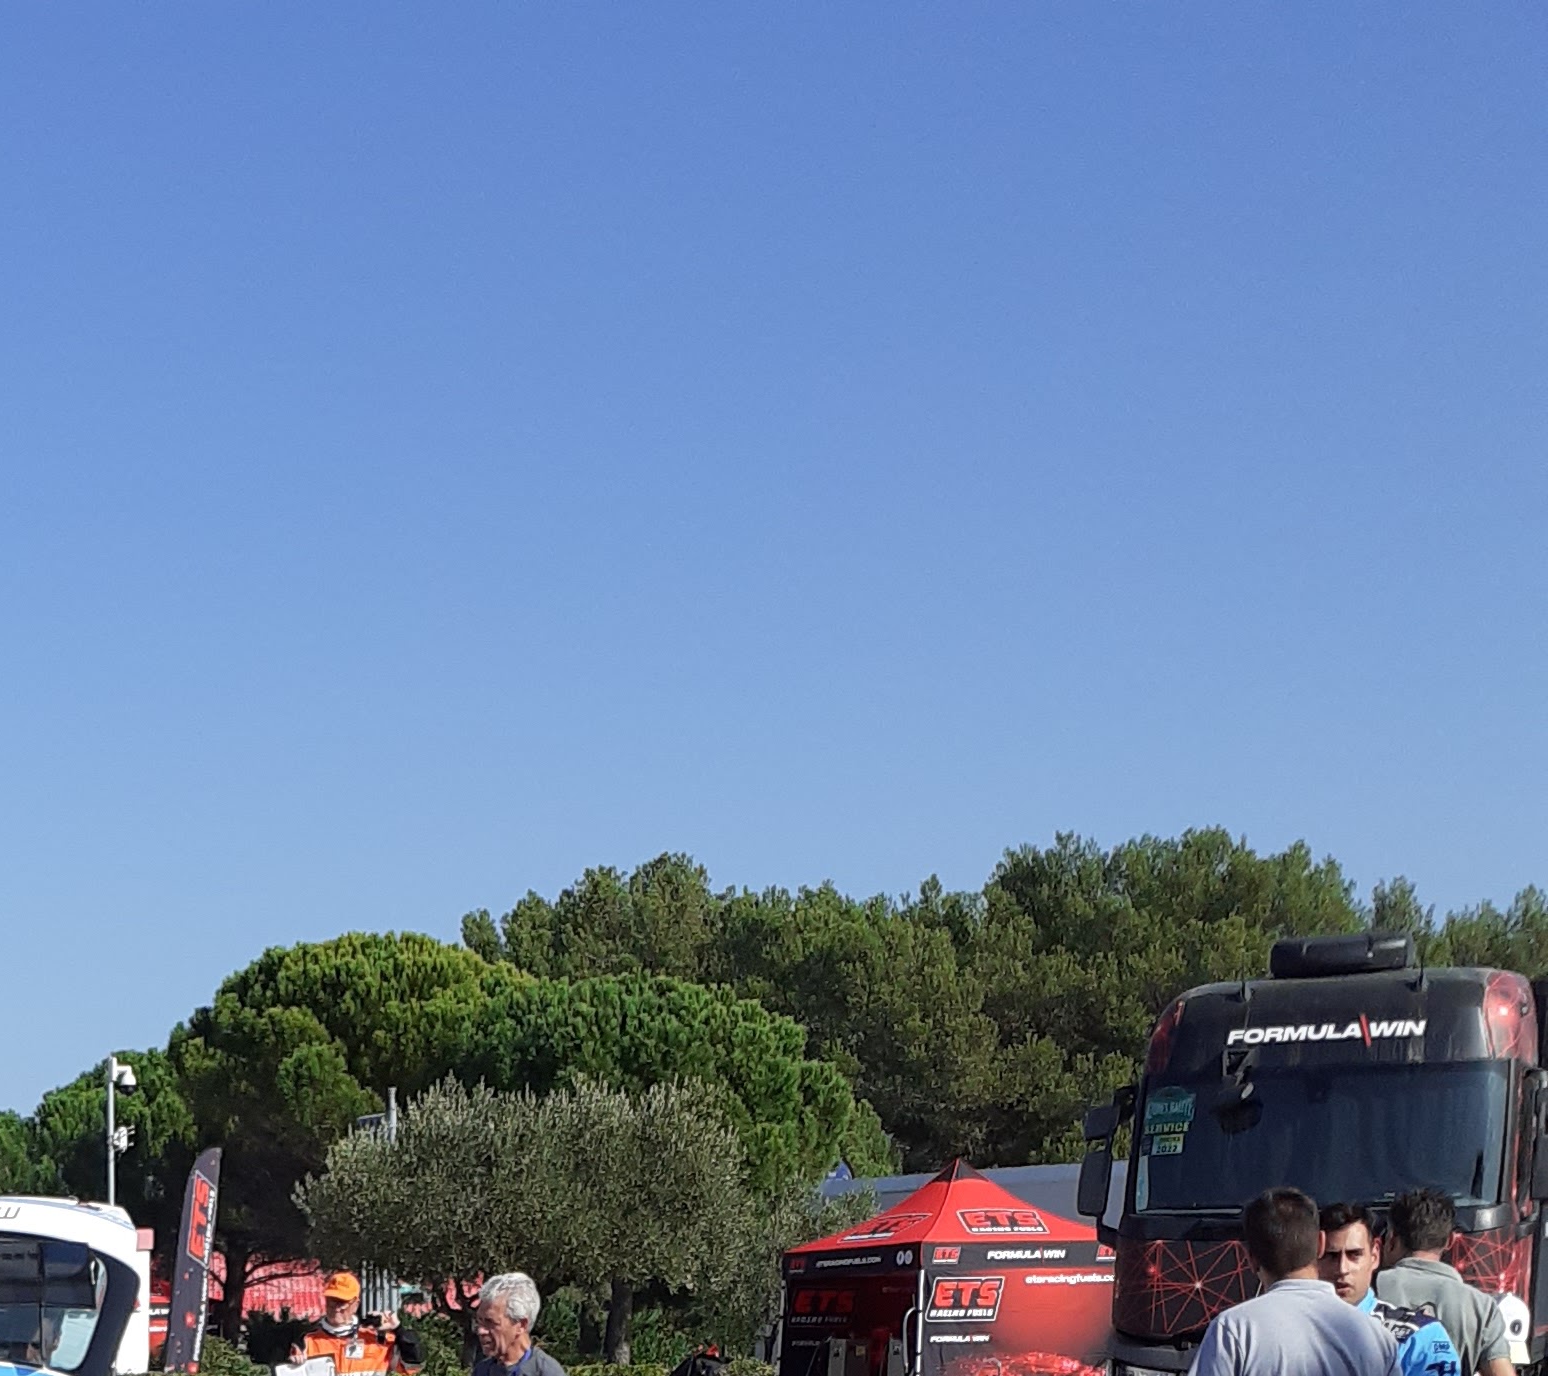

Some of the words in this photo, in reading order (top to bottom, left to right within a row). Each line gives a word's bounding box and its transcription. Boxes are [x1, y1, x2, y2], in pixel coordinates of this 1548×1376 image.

[1226, 1020, 1362, 1046] FORMULA
[1369, 1016, 1428, 1038] WIN
[190, 1178, 210, 1258] ETS
[965, 1211, 1040, 1228] ETS
[986, 1250, 1042, 1260] FORMULA
[1043, 1249, 1066, 1259] WIN
[1097, 1245, 1116, 1259] ET
[934, 1281, 1002, 1307] ETS
